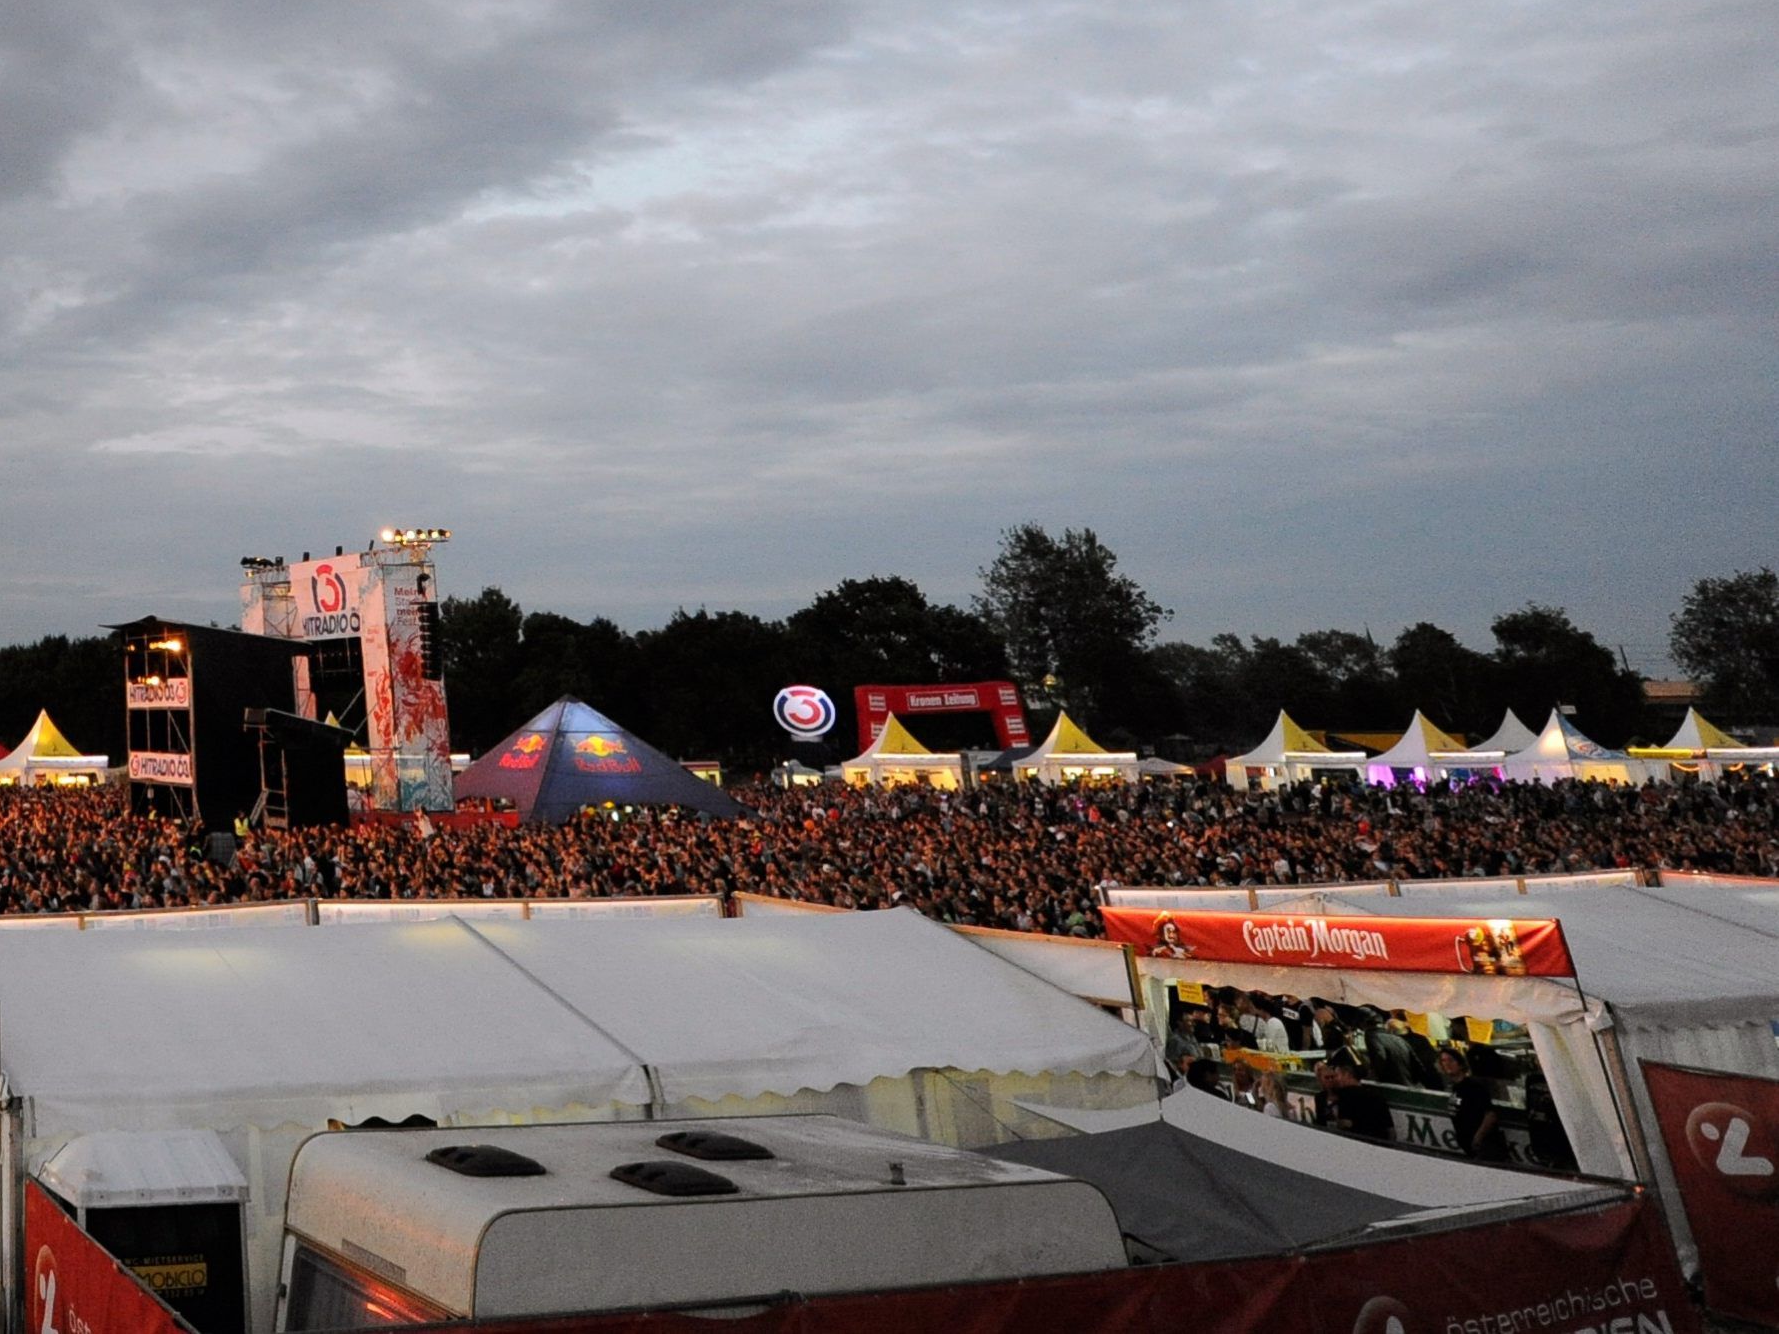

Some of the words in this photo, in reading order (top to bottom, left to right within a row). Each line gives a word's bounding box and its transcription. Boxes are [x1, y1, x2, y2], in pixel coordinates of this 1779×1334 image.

[910, 695, 942, 707] Kronen
[943, 692, 976, 706] Zeitung
[141, 758, 176, 776] HITRADIO
[1242, 918, 1310, 958] Captain
[1305, 918, 1390, 961] Morgan
[1446, 1276, 1659, 1334] österreichische
